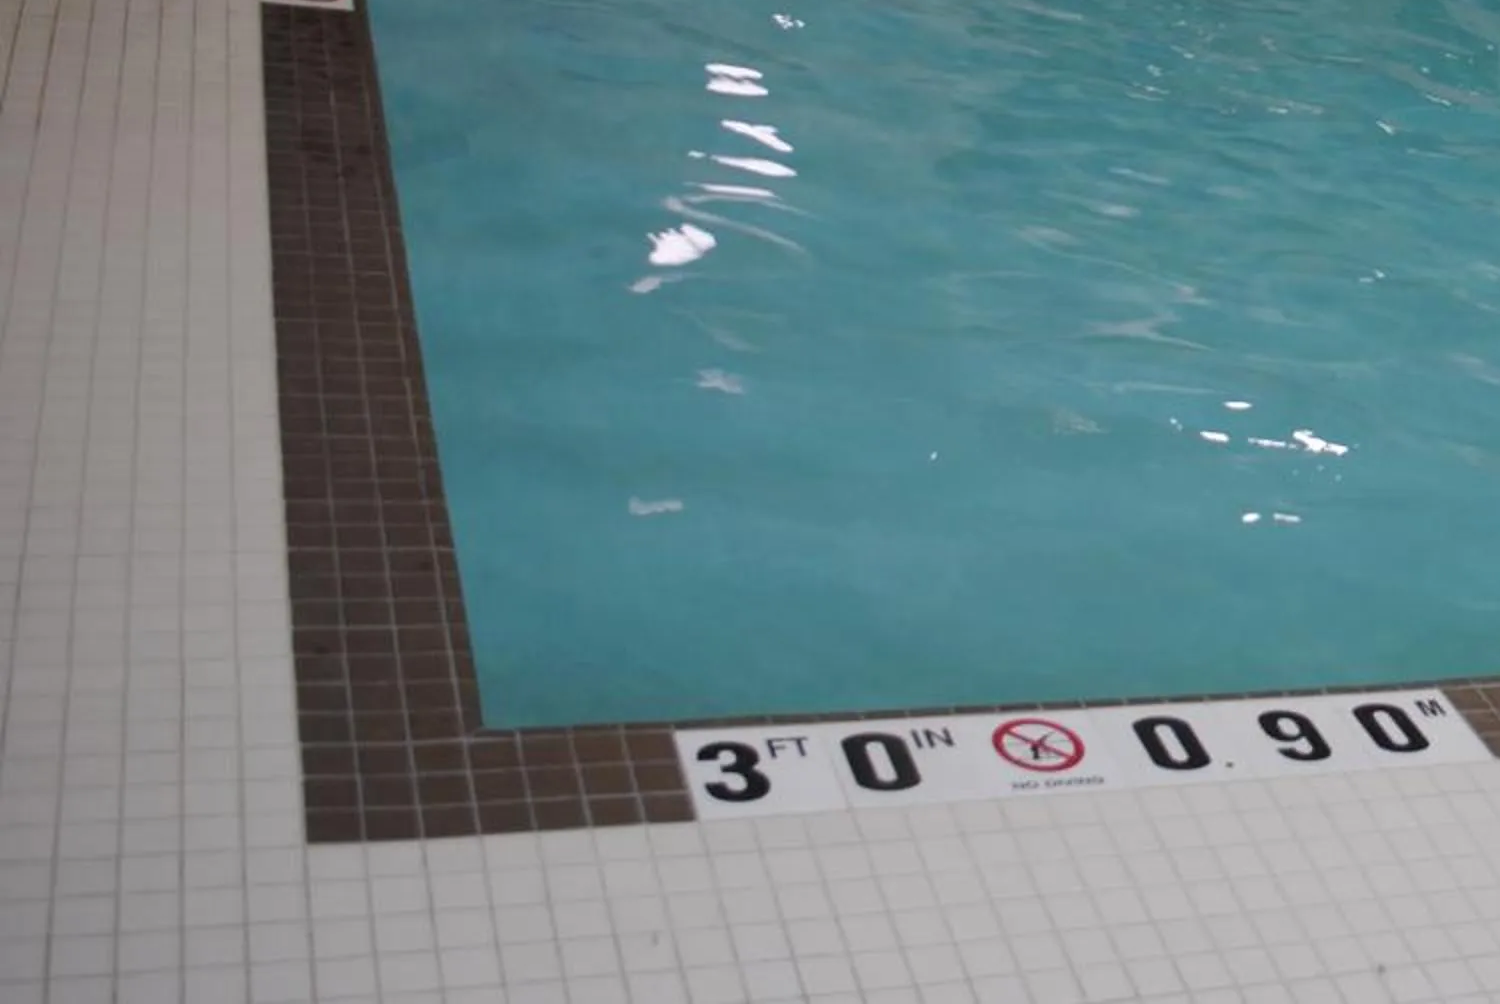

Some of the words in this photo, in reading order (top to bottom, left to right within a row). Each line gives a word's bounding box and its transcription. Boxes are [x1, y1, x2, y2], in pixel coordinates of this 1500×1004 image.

[696, 740, 771, 802] 3
[765, 736, 808, 759] FT
[840, 731, 921, 791] 0
[910, 727, 956, 750] IN
[1414, 699, 1446, 718] M
